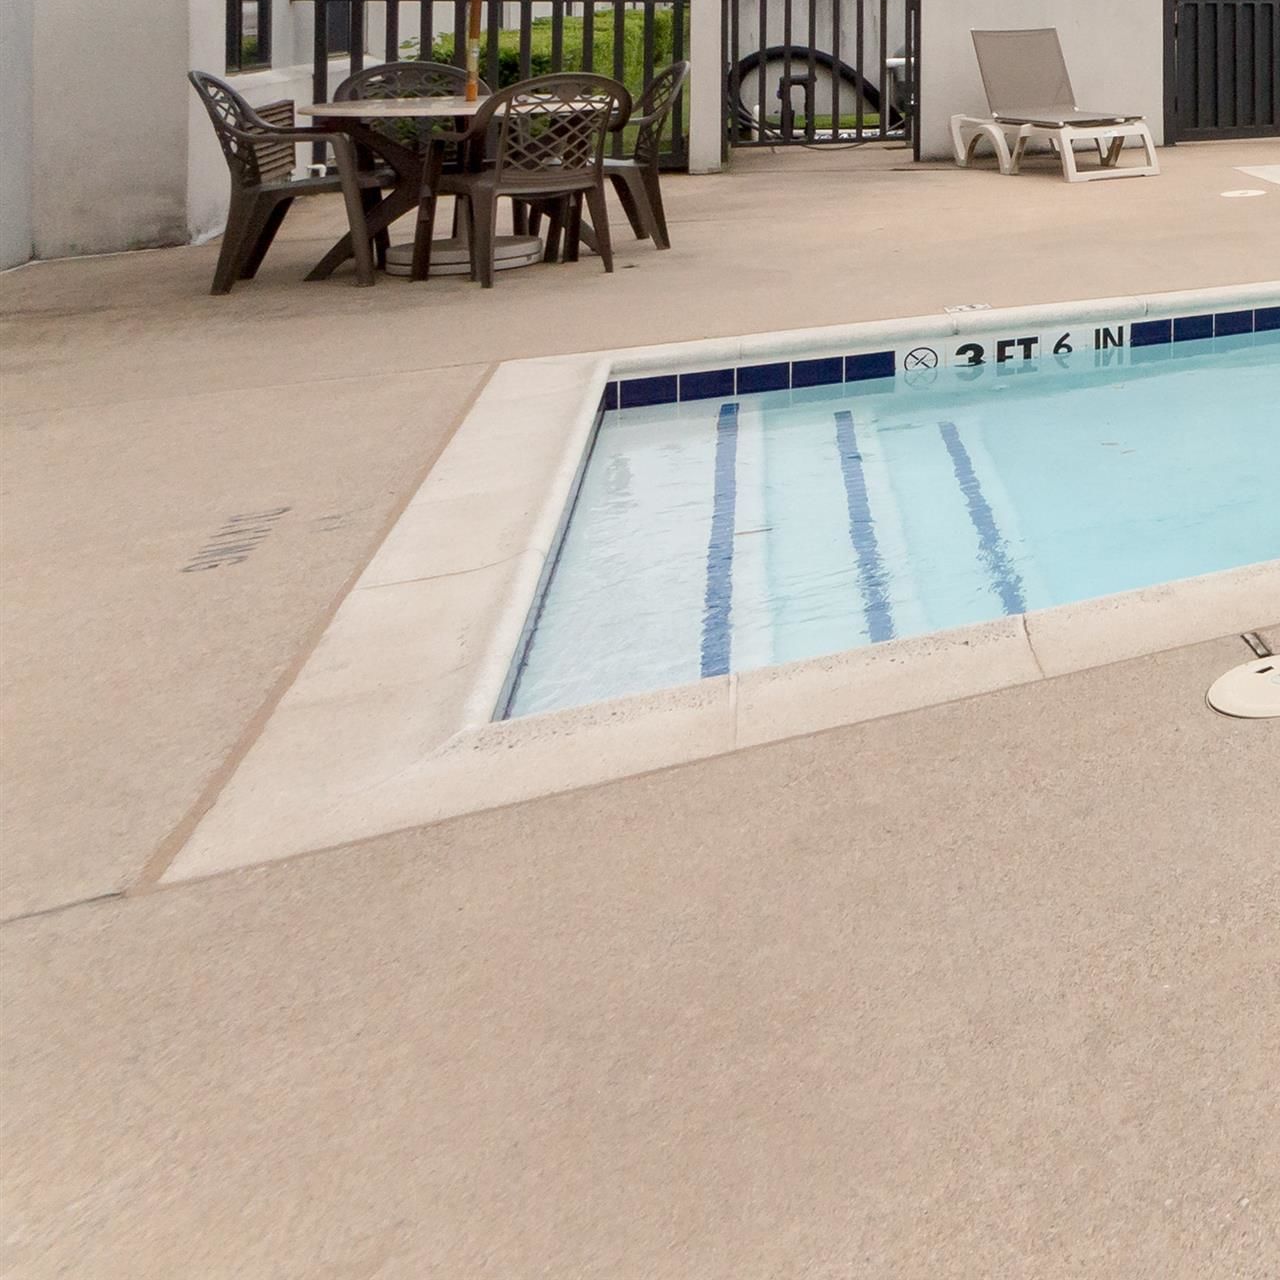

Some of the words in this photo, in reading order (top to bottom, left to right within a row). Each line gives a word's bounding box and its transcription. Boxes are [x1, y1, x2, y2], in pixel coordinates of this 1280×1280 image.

[955, 343, 986, 367] 3
[996, 337, 1039, 363] FT
[1095, 326, 1124, 350] IN
